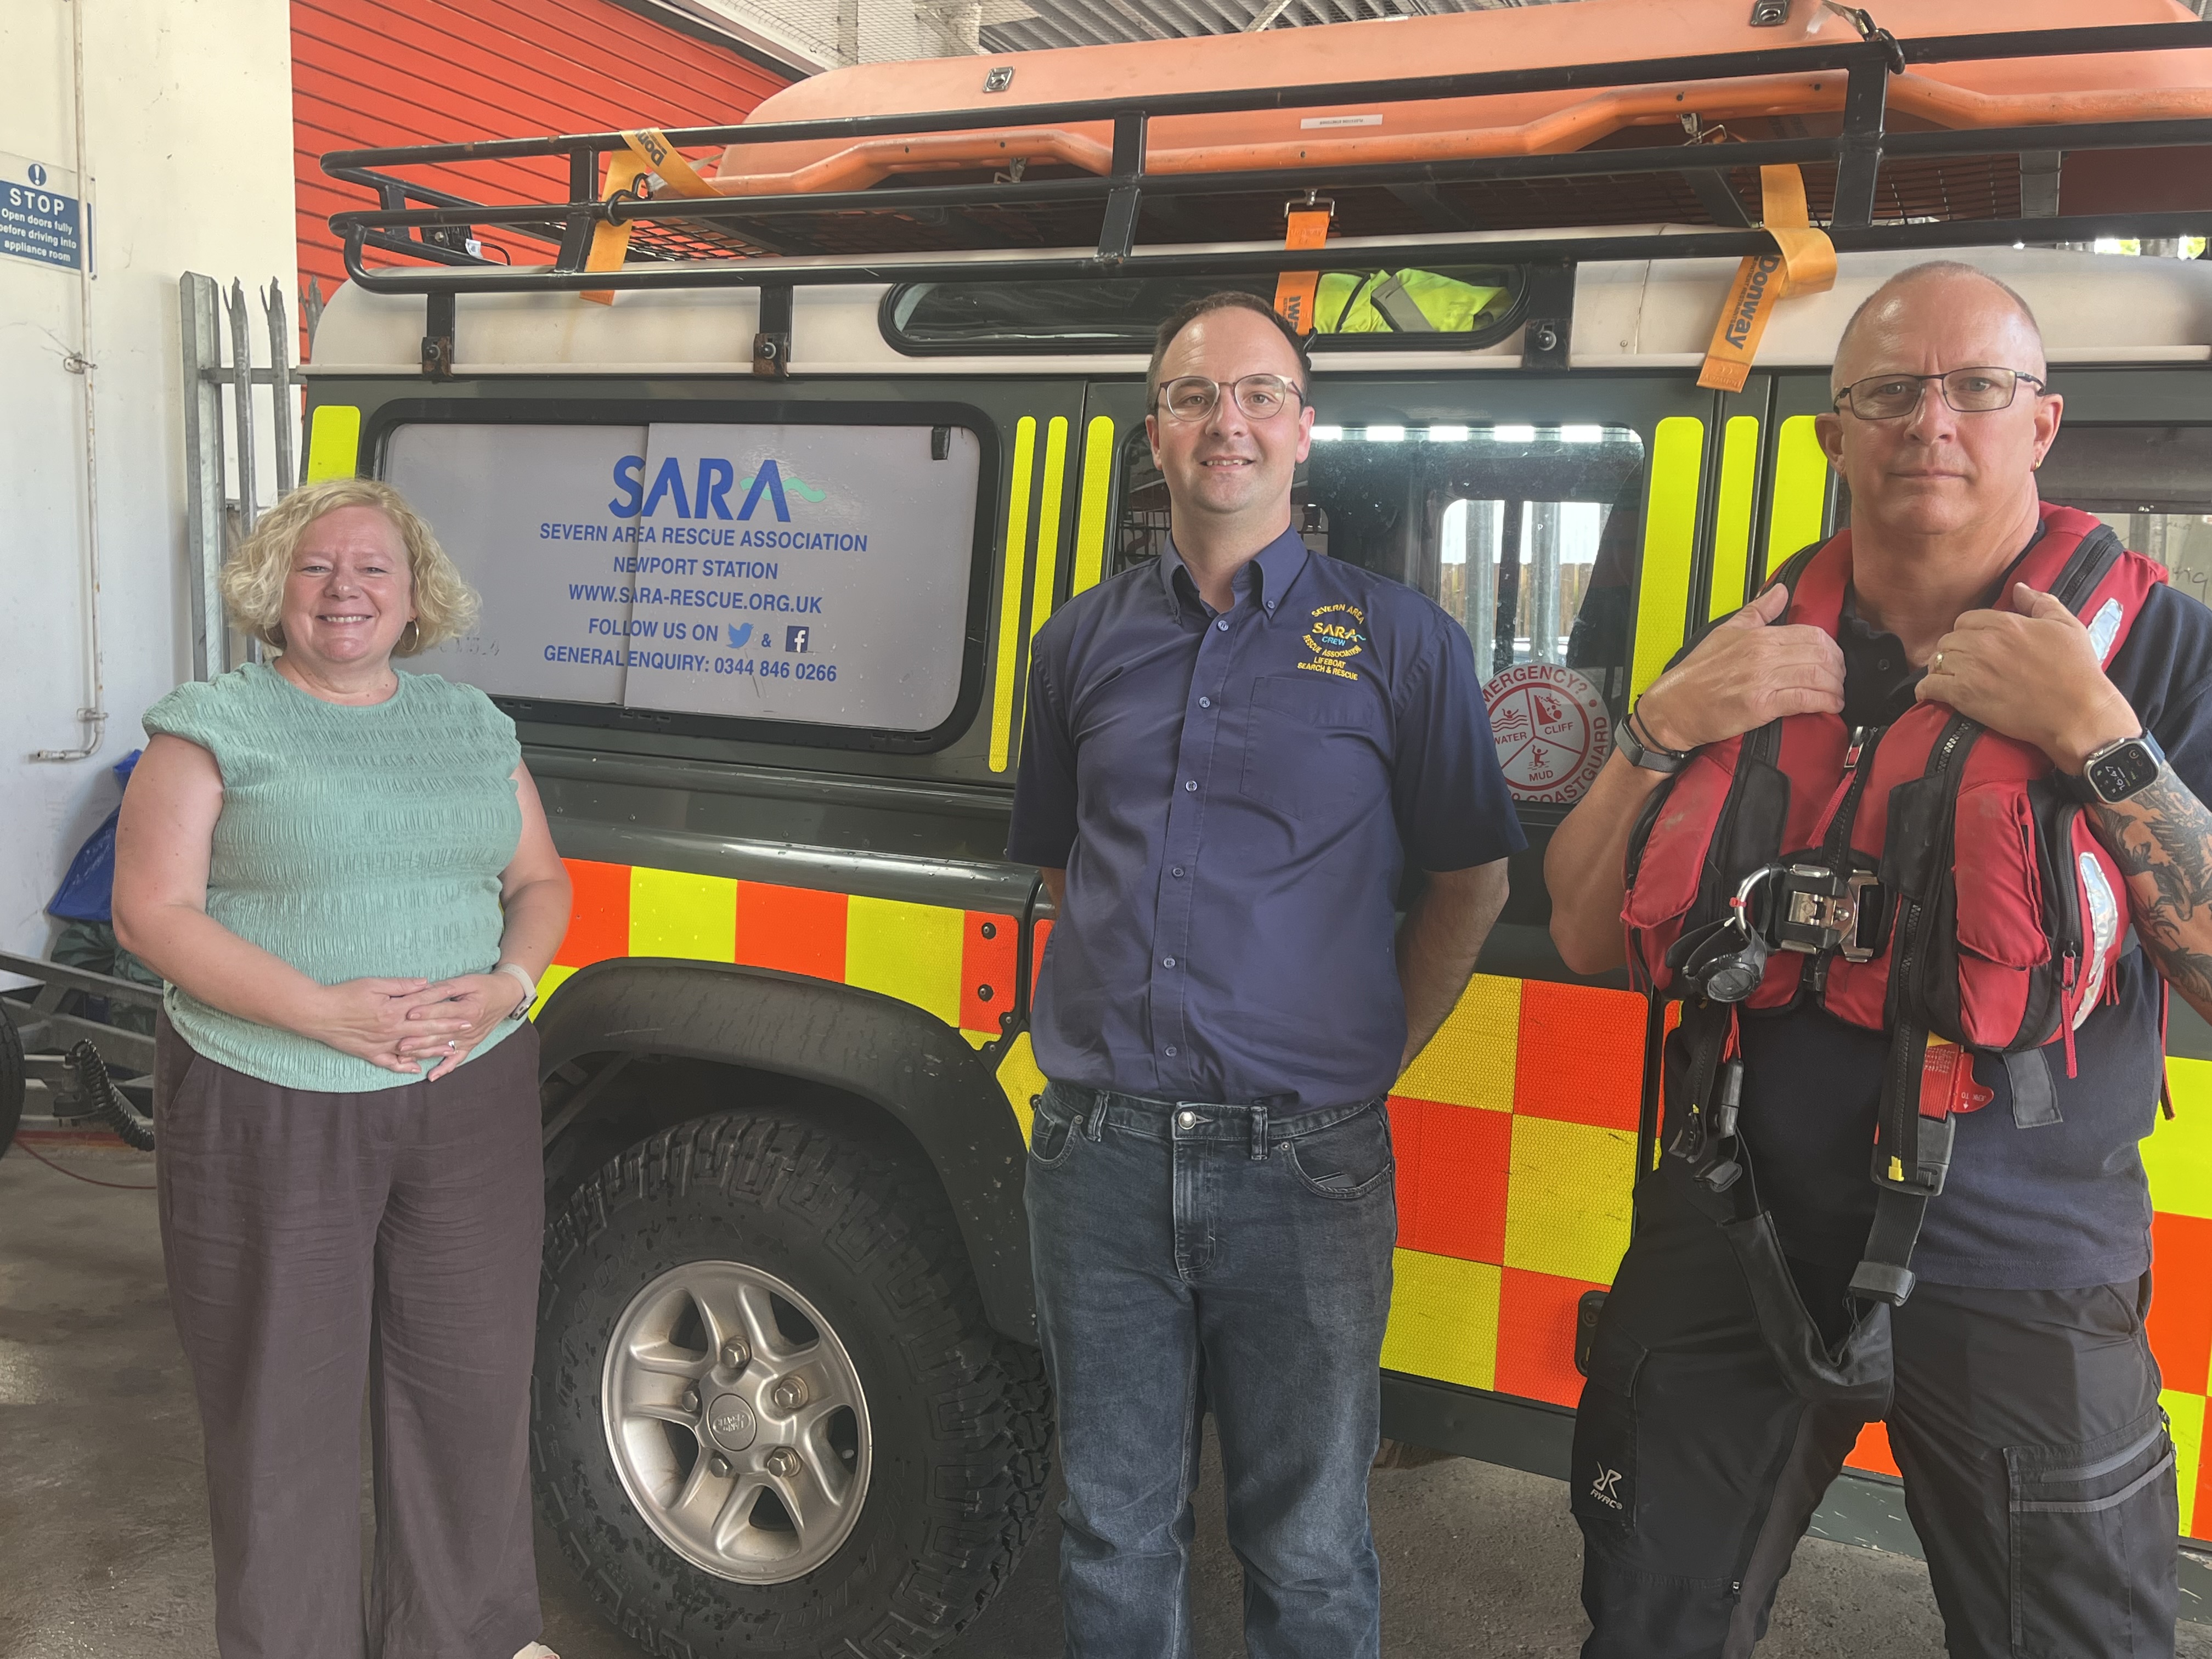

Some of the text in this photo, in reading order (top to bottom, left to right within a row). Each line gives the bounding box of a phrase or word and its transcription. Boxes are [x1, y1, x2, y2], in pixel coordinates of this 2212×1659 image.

[10, 188, 64, 216] STOP
[2, 208, 73, 235] Open doors fully
[4, 240, 71, 262] appliance room
[29, 230, 58, 246] driving
[61, 236, 77, 249] into
[1725, 256, 1780, 349] Donway
[608, 455, 791, 522] SARA
[540, 523, 868, 552] SEVERN AREA RESCUE ASSOCIATION
[613, 556, 778, 579] NEWPORT STATION
[569, 584, 822, 614] WWW.SARA-RESCUE.ORG.UK
[1311, 603, 1365, 624] SEVERN AREA
[589, 618, 658, 637] FOLLOW
[663, 623, 687, 639] US
[692, 624, 719, 642] ON
[761, 634, 771, 648] &
[1312, 622, 1358, 642] SARA
[1322, 636, 1346, 646] CREW
[1302, 634, 1362, 657] RESCUE ASSOCIATION
[544, 645, 837, 682] GENERAL ENQUIRY: 0344 846 0266
[1297, 662, 1325, 673] SEARCH
[1333, 668, 1359, 681] RESCUE
[1314, 656, 1346, 669] LIFEBOAT
[1482, 665, 1588, 703] MERGENCY?
[1544, 722, 1574, 735] CLIFF
[1528, 770, 1554, 782] MUD
